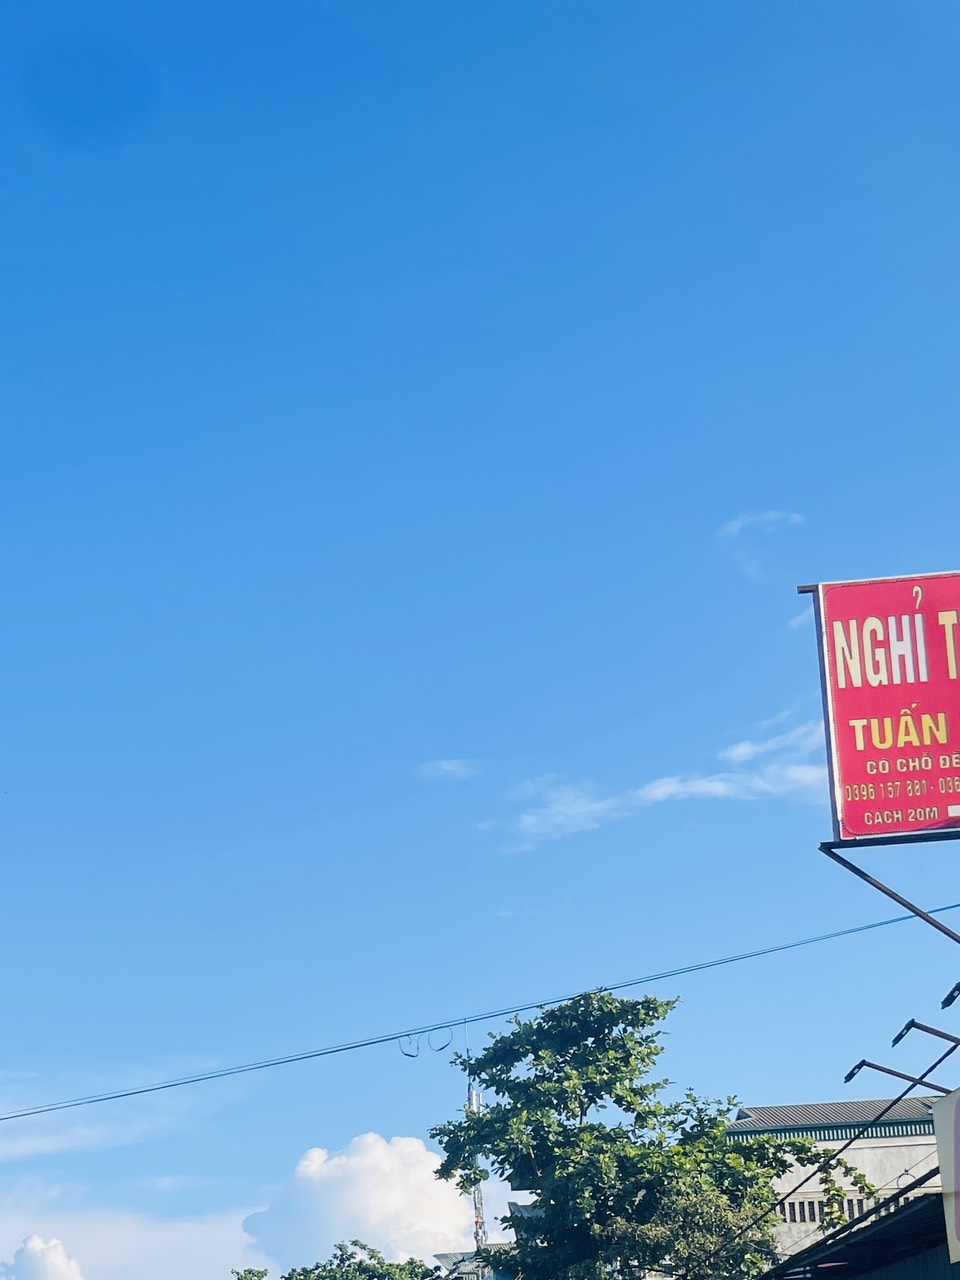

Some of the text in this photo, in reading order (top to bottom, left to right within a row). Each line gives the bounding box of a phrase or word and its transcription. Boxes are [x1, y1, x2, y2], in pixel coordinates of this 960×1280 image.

[833, 586, 928, 688] NGHỈ
[849, 702, 949, 751] TUẤN
[866, 757, 890, 775] CÓ
[896, 751, 933, 773] CHỖ
